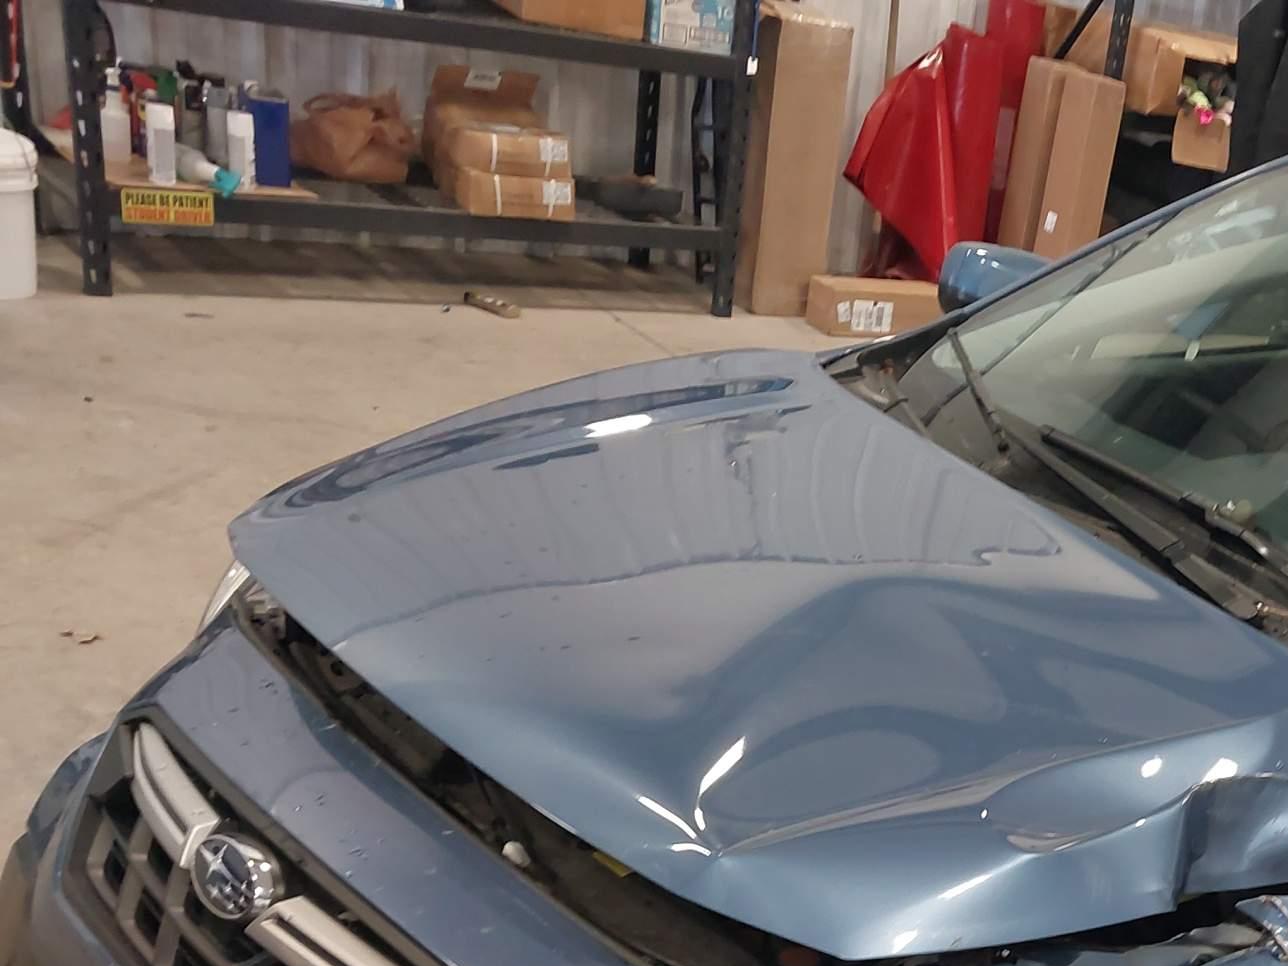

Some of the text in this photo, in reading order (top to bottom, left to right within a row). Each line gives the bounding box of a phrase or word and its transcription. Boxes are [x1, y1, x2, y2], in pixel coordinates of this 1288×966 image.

[125, 192, 210, 209] PLEASE BE PATIENT
